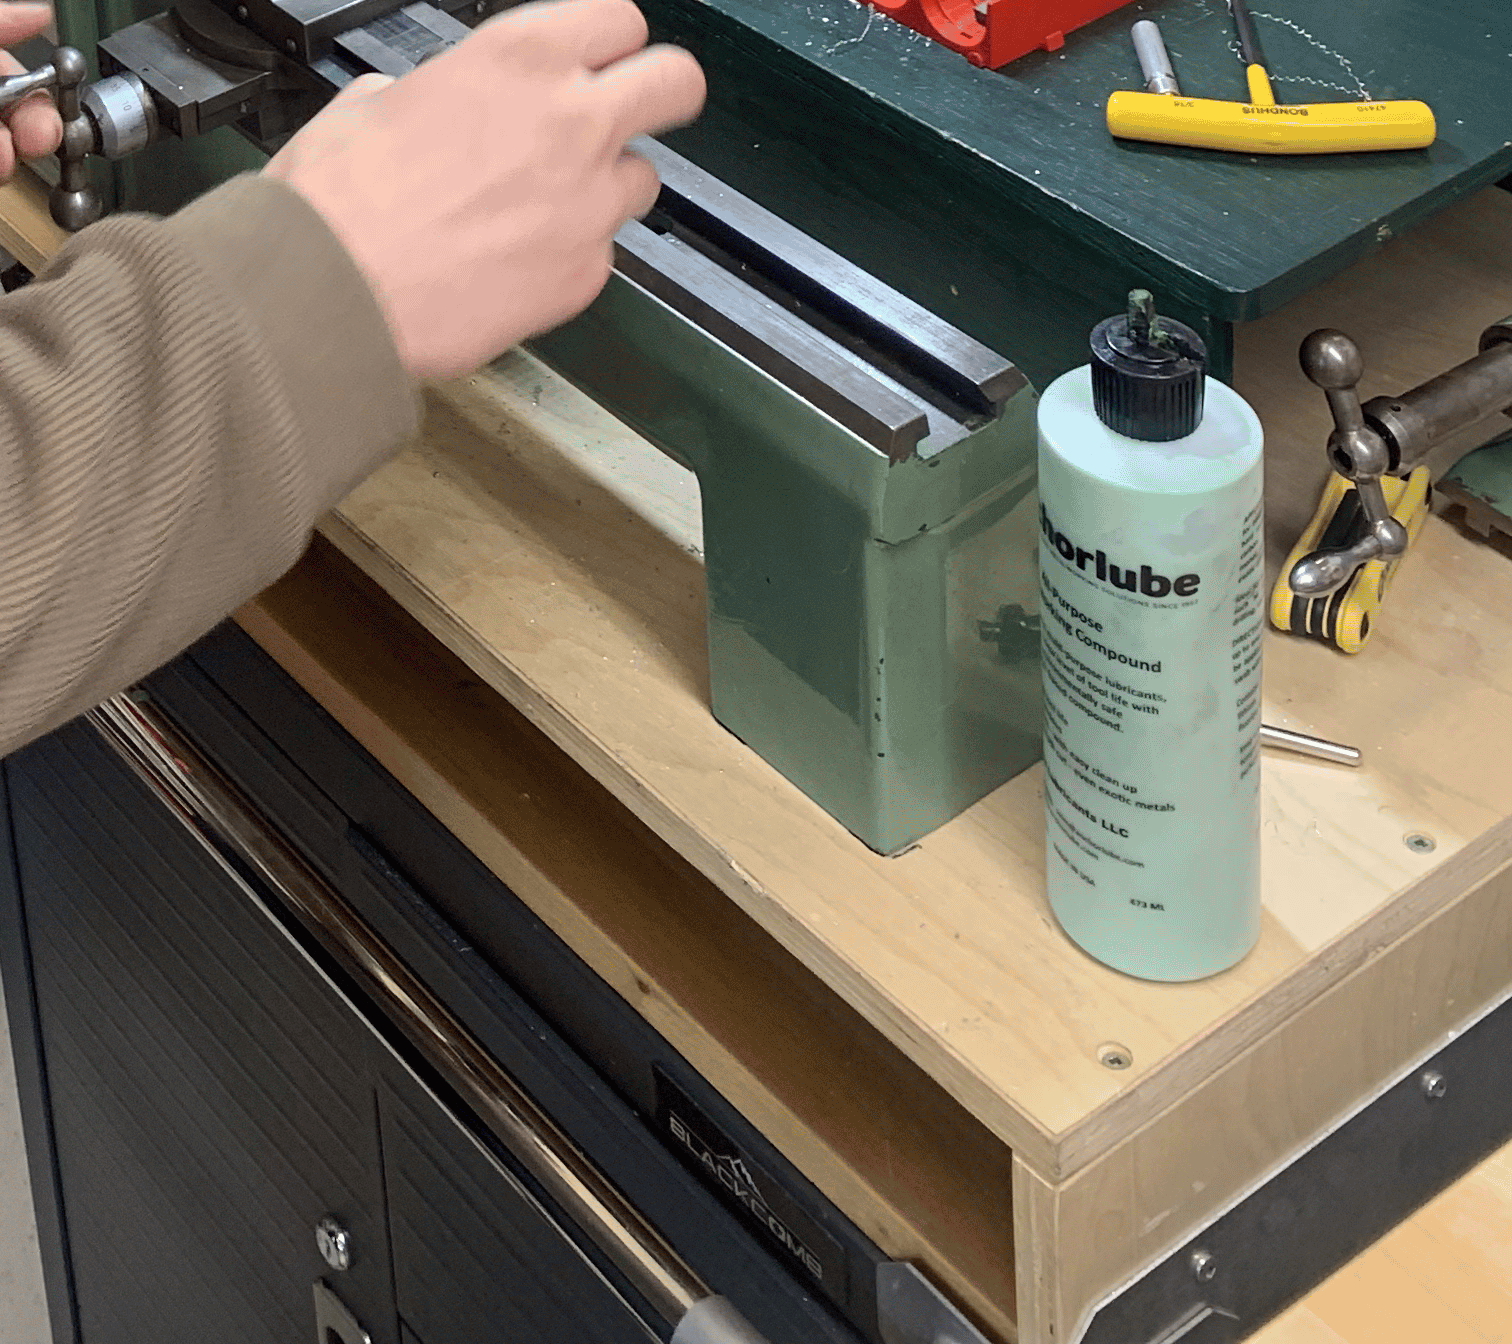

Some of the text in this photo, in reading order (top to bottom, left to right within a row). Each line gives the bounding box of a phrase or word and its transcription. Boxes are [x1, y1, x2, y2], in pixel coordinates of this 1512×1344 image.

[1242, 106, 1309, 117] BONDHUS
[1075, 628, 1161, 673] Compound
[1088, 681, 1108, 698] tool
[1111, 693, 1128, 708] life
[1131, 703, 1159, 715] with
[1105, 676, 1167, 703] lubricants,
[1068, 696, 1124, 733] compound.
[1101, 703, 1123, 719] safe
[1074, 768, 1096, 788] even
[1098, 786, 1132, 806] exotic
[1135, 801, 1176, 812] metals
[1092, 767, 1119, 787] clean
[1101, 819, 1129, 838] LLC
[670, 1116, 823, 1279] BLACKCOMB
